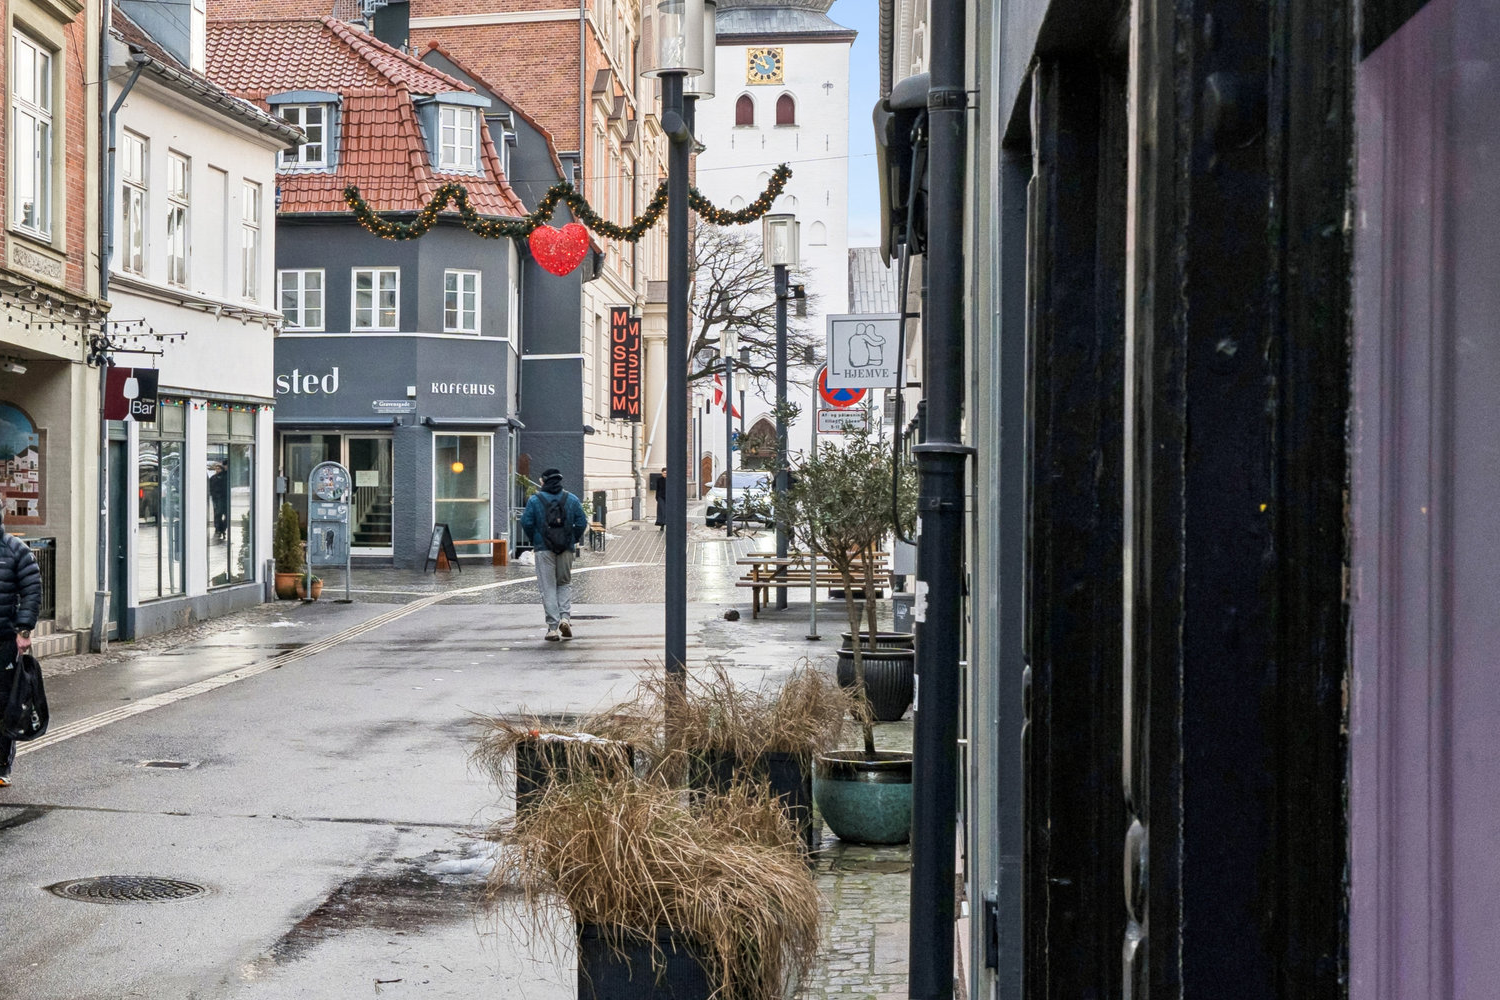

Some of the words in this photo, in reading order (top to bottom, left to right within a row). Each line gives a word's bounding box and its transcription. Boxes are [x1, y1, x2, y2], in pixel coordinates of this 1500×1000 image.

[612, 311, 627, 411] MUSEUM
[275, 366, 339, 395] sted
[844, 369, 889, 378] HJEMVE
[132, 400, 155, 415] Bar
